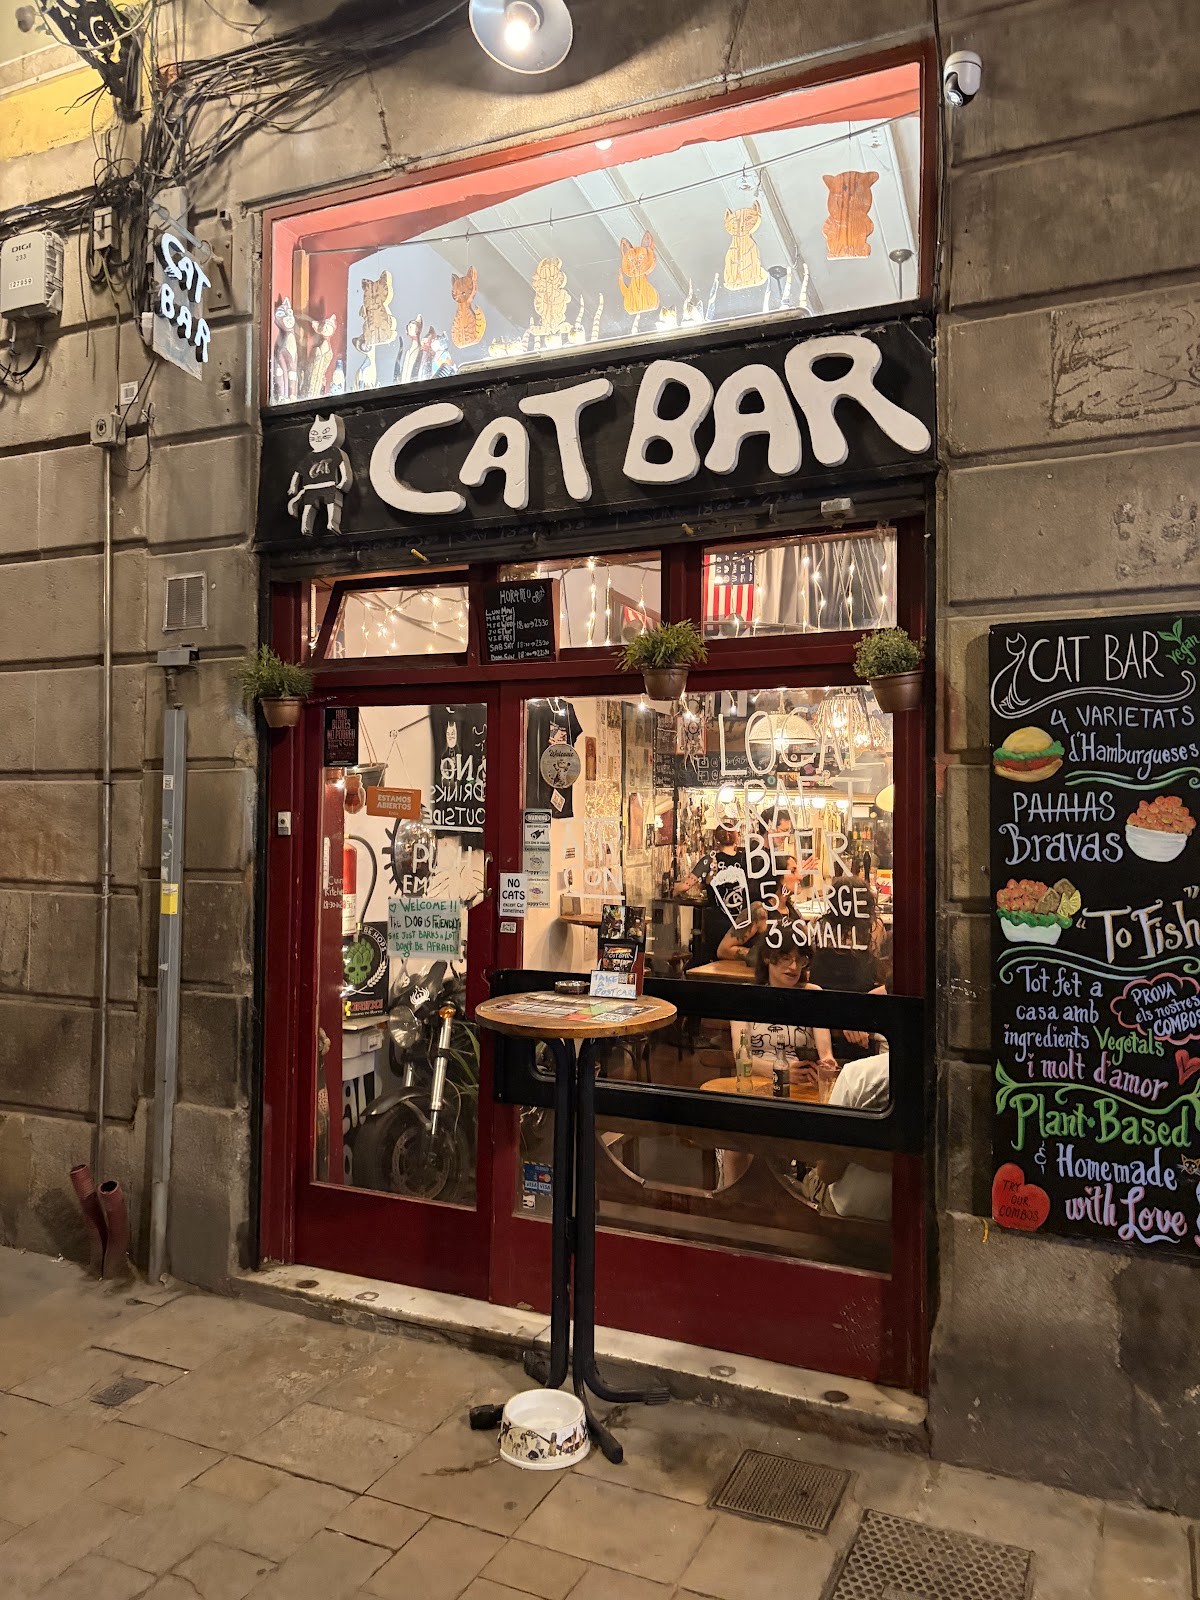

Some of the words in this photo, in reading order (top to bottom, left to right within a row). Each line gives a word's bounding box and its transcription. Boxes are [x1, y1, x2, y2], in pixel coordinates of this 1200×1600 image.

[11, 243, 32, 253] DIGI
[161, 232, 211, 303] CAT
[161, 284, 211, 363] BAR
[369, 378, 612, 513] CAT
[623, 334, 931, 485] BAR
[309, 458, 333, 479] CAT
[1028, 635, 1090, 683] CAT
[1105, 630, 1164, 681] BAR
[1165, 634, 1200, 666] vegan
[1050, 709, 1069, 733] 4
[1076, 704, 1194, 728] VARIETATS
[549, 749, 574, 758] Welcome
[717, 707, 885, 776] LOCAL
[377, 795, 412, 803] ESTAMOS
[377, 802, 412, 810] ABIERTOS
[715, 776, 872, 831] CRAFT
[744, 831, 853, 879] BEER
[999, 822, 1124, 865] Bravas
[502, 890, 525, 900] CATS
[508, 878, 520, 888] NO
[399, 899, 446, 913] WELCOME
[791, 887, 870, 918] LARGE
[402, 931, 416, 939] JUST
[418, 931, 439, 940] BARKS
[405, 916, 423, 928] DOG
[425, 916, 431, 927] IS
[791, 918, 868, 951] SMALL
[415, 942, 424, 951] BE
[594, 973, 617, 983] TAKE
[1016, 962, 1050, 993] Tot
[1053, 967, 1082, 998] fet
[1089, 981, 1103, 997] a
[1131, 981, 1177, 1007] PROVA
[1016, 1004, 1059, 1020] casa
[1063, 999, 1099, 1023] amb
[1136, 1008, 1154, 1023] els
[1154, 995, 1200, 1018] nostres
[1004, 1023, 1089, 1062] ingredients
[1093, 1025, 1165, 1066] Vegetals
[1027, 1053, 1035, 1078] i
[1041, 1049, 1085, 1080] molt
[1093, 1051, 1169, 1101] d'amor
[1056, 1143, 1177, 1191] Homemade
[1003, 1179, 1022, 1192] TRY
[999, 1205, 1038, 1221] COMBOS
[1010, 1195, 1030, 1206] OUR
[1065, 1183, 1117, 1227] with
[1118, 1186, 1188, 1243] Love
